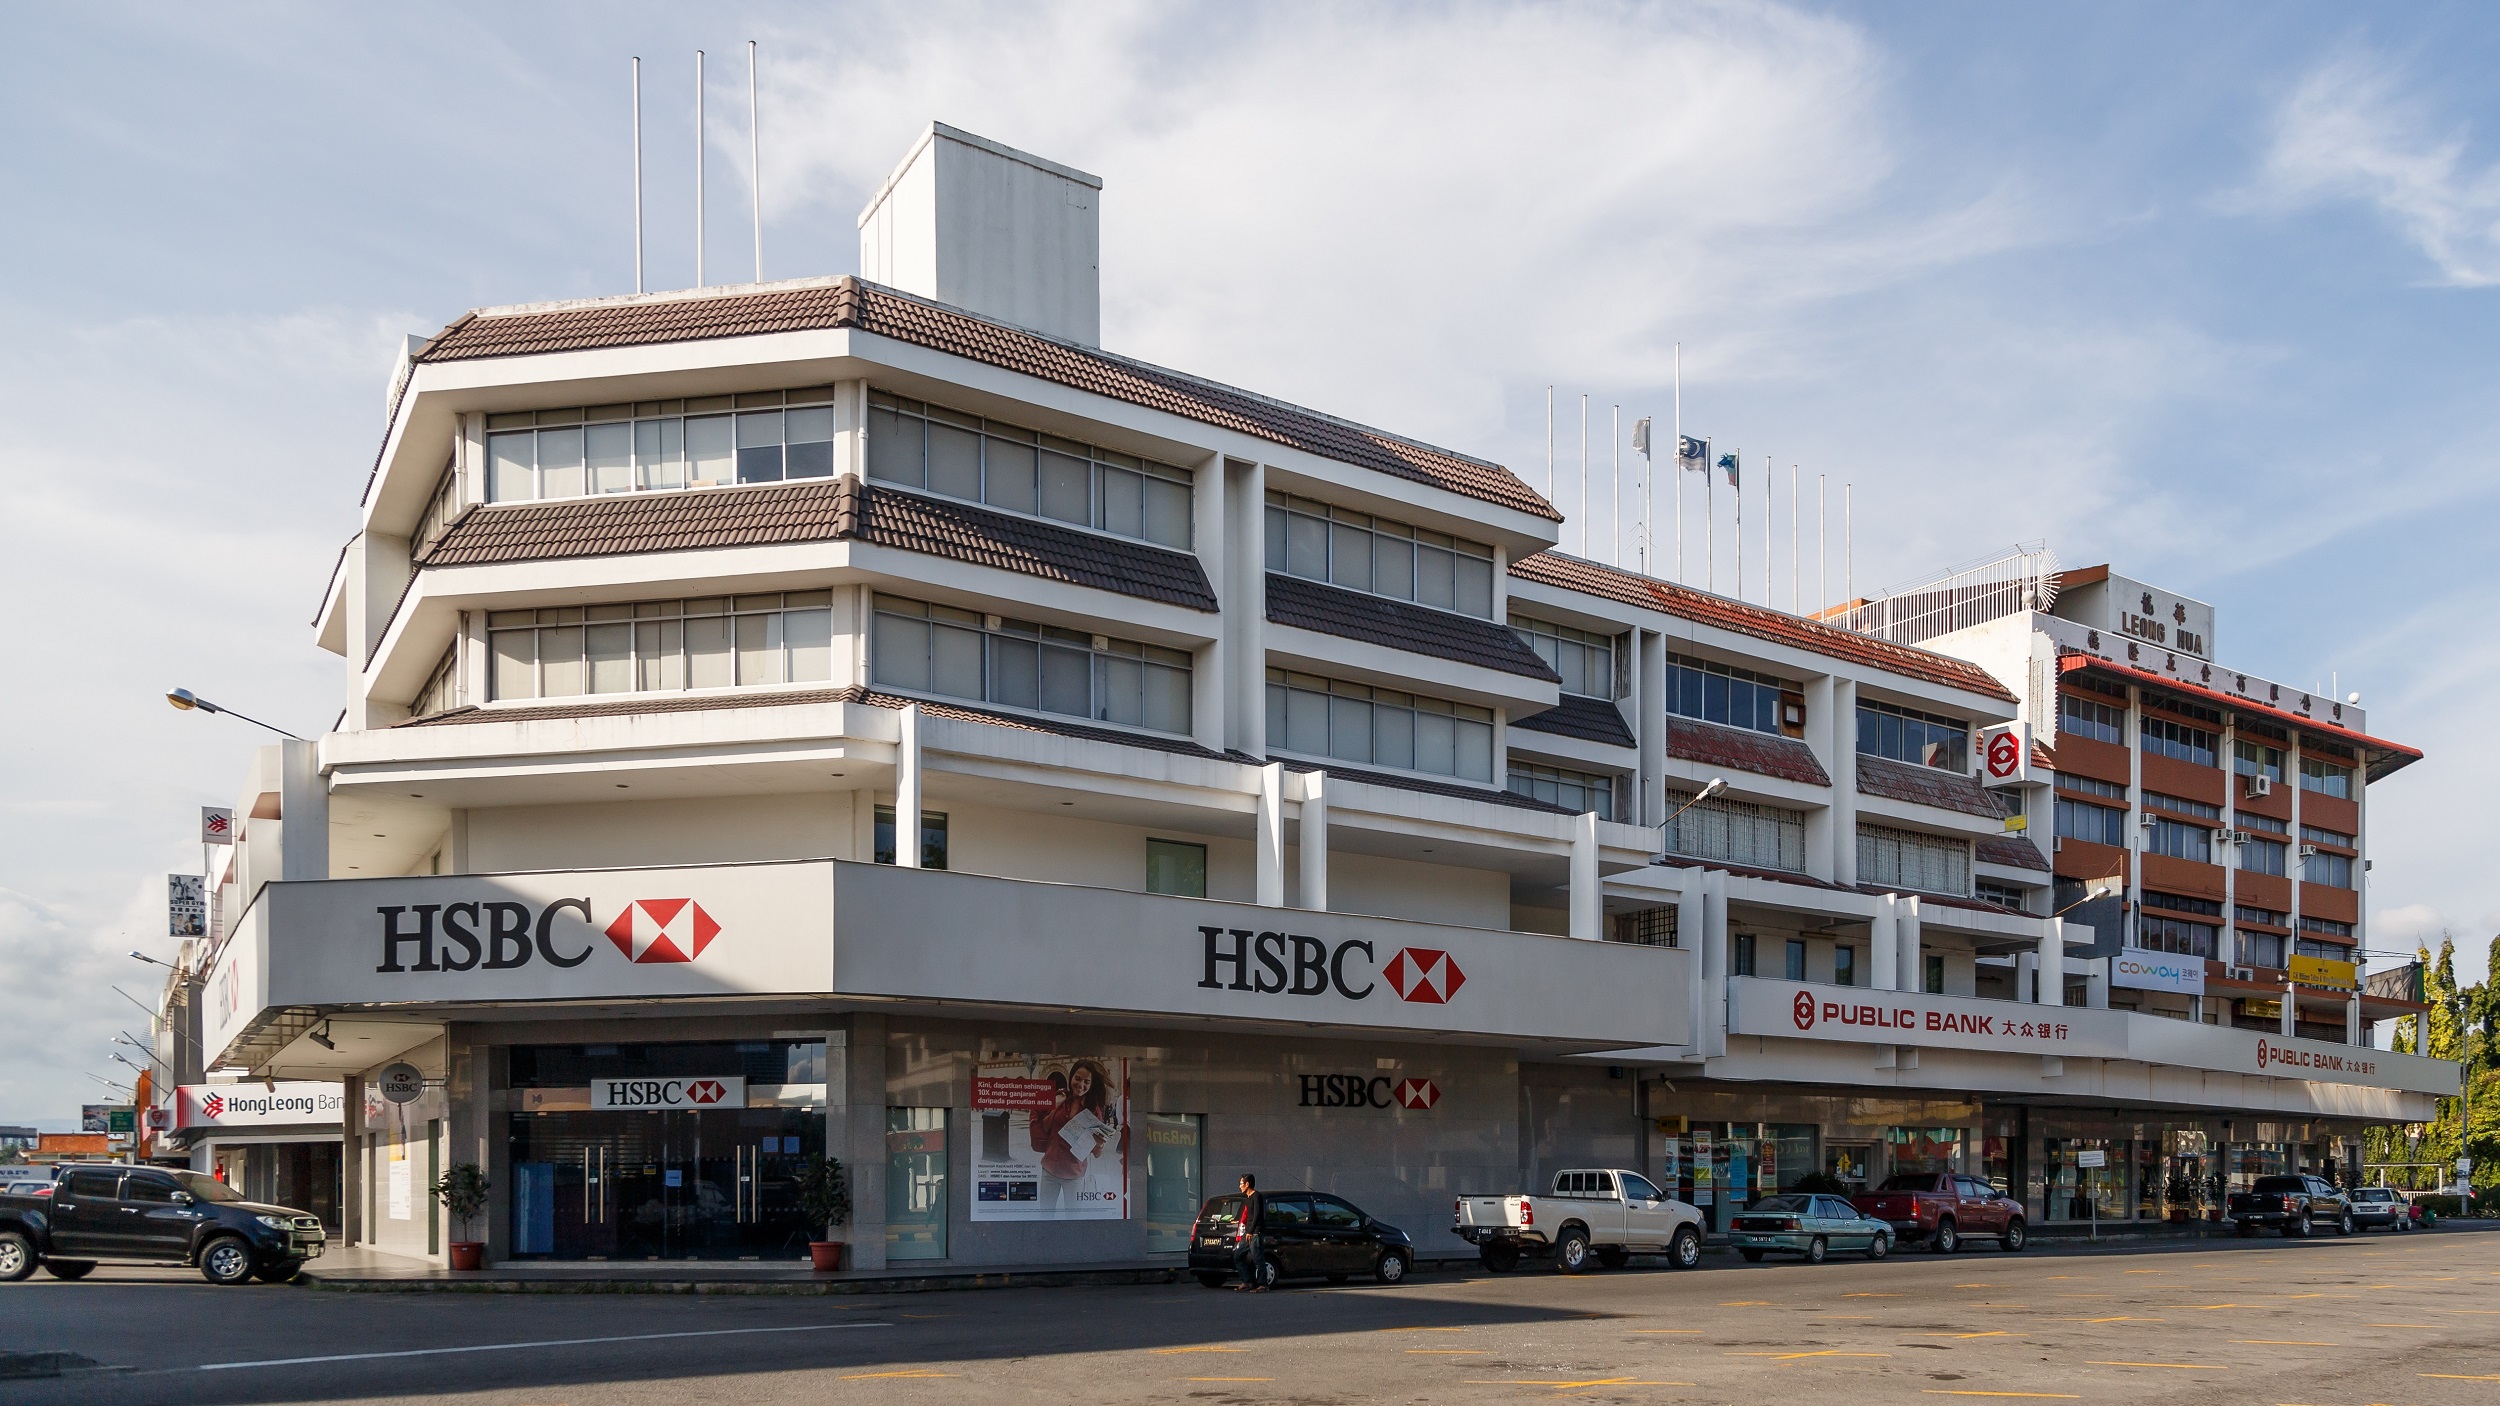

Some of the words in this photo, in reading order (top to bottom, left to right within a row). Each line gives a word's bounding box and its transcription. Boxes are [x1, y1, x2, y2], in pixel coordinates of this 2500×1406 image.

[2122, 611, 2166, 644] LEONG
[2177, 628, 2203, 656] HUA
[375, 897, 594, 973] HSBC
[1197, 925, 1376, 1001] HSBC
[2119, 961, 2179, 984] coway
[1822, 1002, 1916, 1029] PUBLIC
[1925, 1011, 1994, 1035] BANK
[2002, 1019, 2069, 1041] 大众银行
[2270, 1047, 2310, 1067] PUBLIC
[2313, 1053, 2343, 1071] BANK
[2346, 1060, 2376, 1075] 大众银行
[385, 1083, 418, 1093] HSBC
[607, 1080, 682, 1106] HSBC
[993, 1082, 1023, 1090] dapatkan
[1023, 1083, 1052, 1091] sehingga
[1298, 1073, 1392, 1109] HSBC
[977, 1097, 1005, 1105] daripada
[1006, 1098, 1036, 1106] percutian
[1076, 1191, 1102, 1201] HSBC
